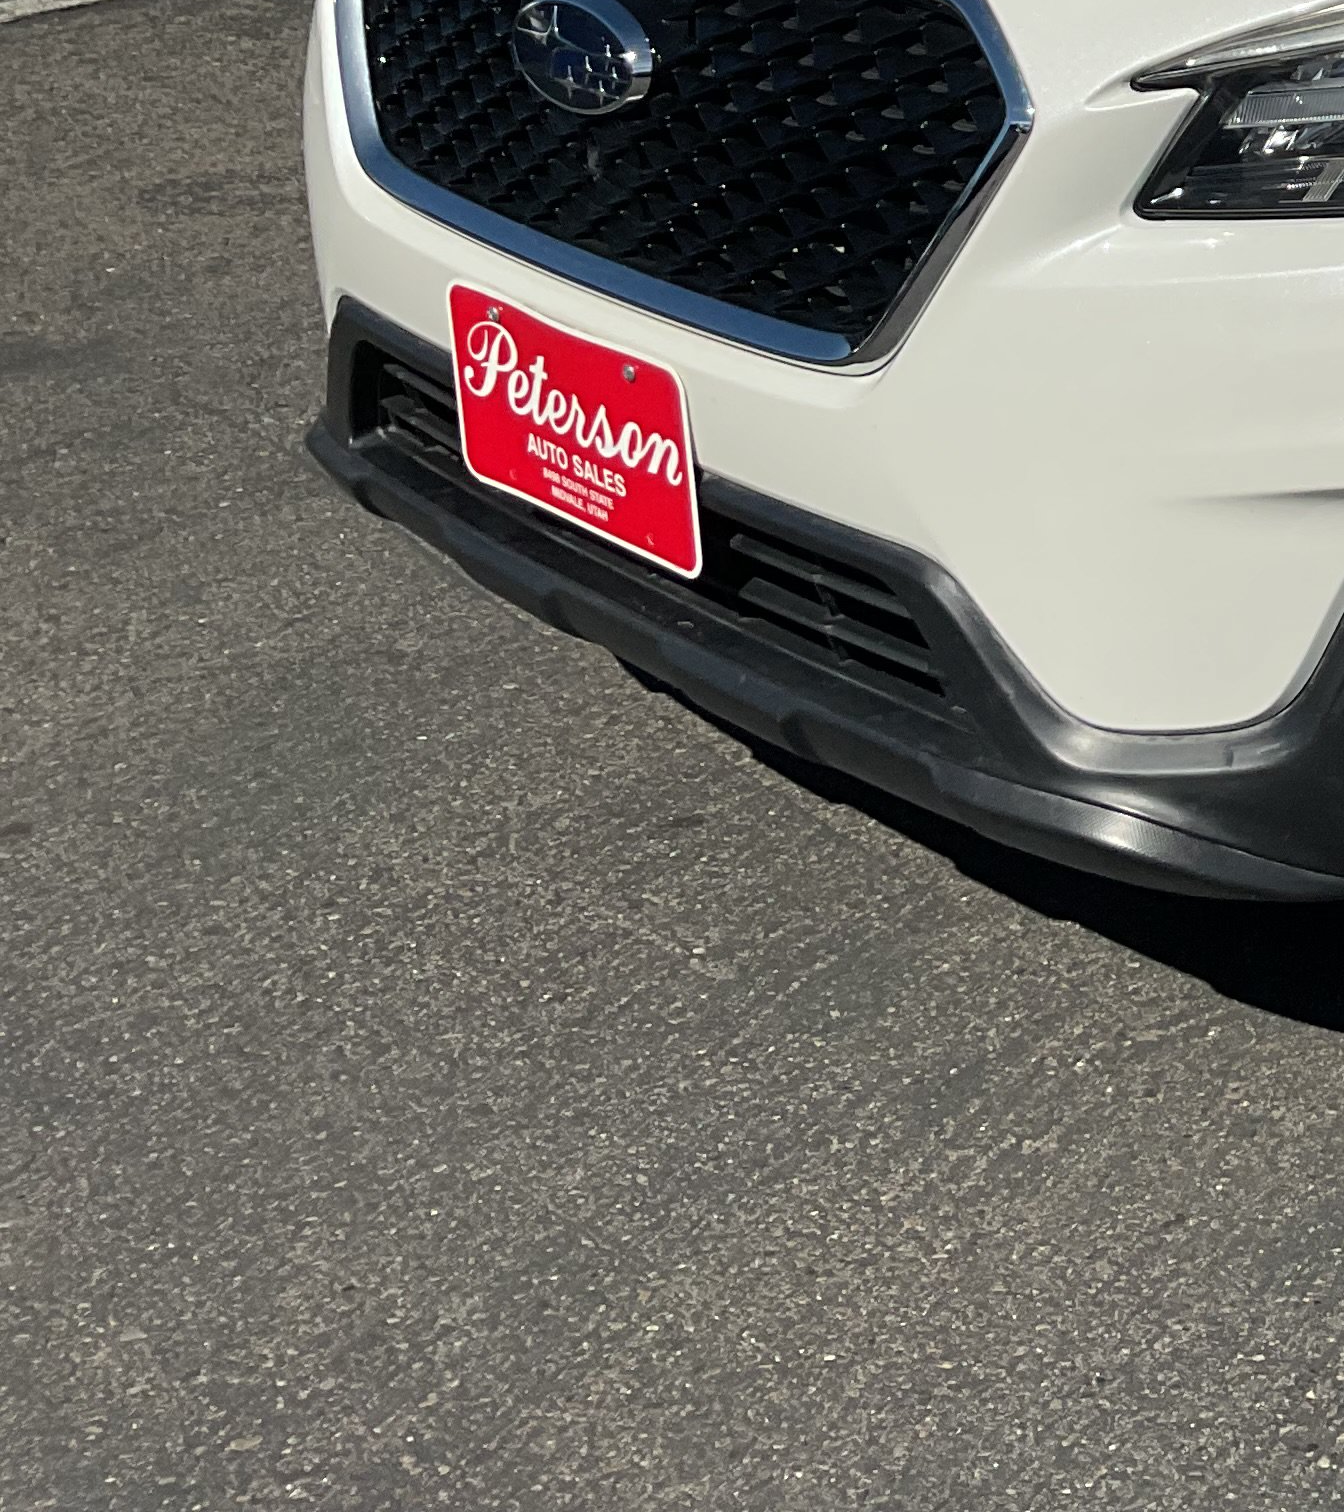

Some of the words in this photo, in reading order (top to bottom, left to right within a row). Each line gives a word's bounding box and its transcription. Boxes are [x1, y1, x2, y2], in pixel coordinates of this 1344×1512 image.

[463, 320, 683, 487] Peterson
[526, 432, 569, 471] AUTO
[572, 455, 627, 497] SALES
